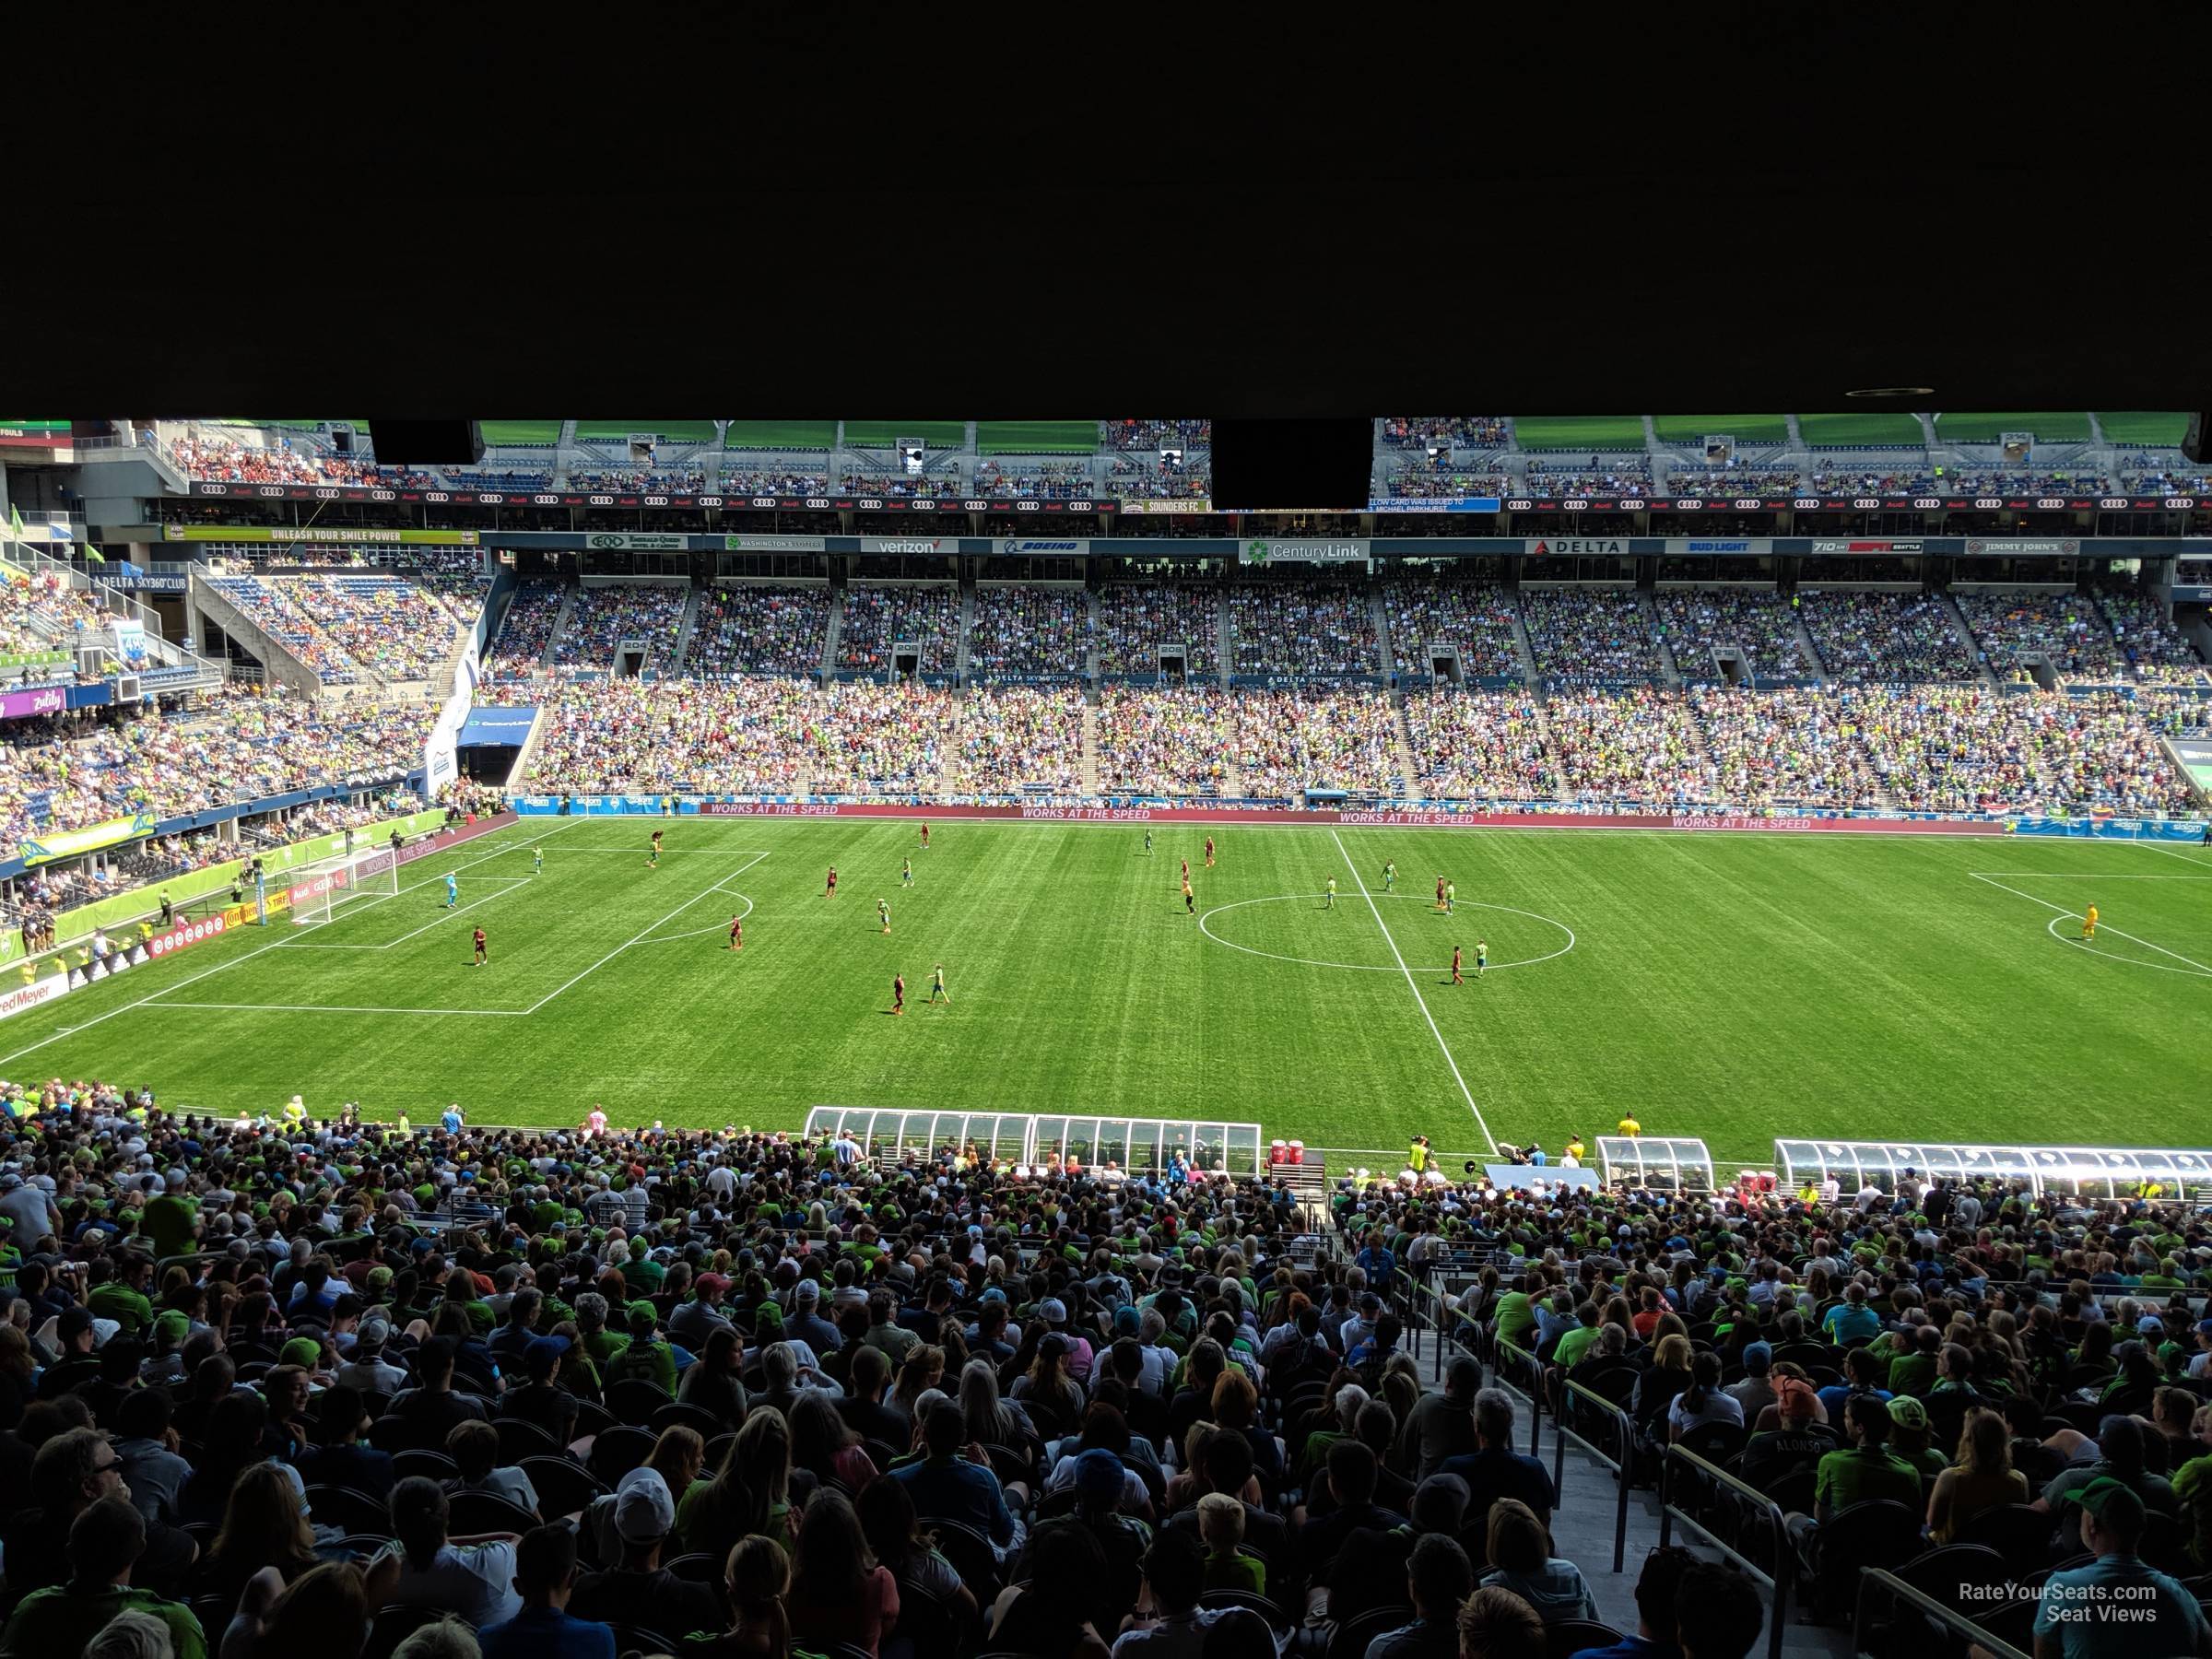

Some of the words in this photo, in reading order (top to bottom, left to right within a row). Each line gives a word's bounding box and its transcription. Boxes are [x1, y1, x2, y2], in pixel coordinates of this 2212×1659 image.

[1148, 502, 1188, 512] SOUNDERS
[1189, 502, 1198, 512] FC
[272, 530, 312, 540] UNLEASH
[314, 531, 338, 540] YOUR
[340, 531, 368, 541] SMILE
[370, 532, 401, 541] POWER
[879, 541, 934, 554] verizon
[1022, 542, 1077, 551] BOEING
[1273, 544, 1359, 559] CenturyLink
[1557, 541, 1620, 552] DELTA
[1688, 542, 1712, 551] BUD
[1714, 542, 1749, 551] LIGHT
[1814, 542, 1836, 551] 710
[1986, 543, 2020, 551] JIMMY
[2022, 543, 2059, 552] JOHN'S
[103, 577, 135, 588] DELTA
[168, 578, 186, 589] CLUB
[711, 804, 753, 813] WORKS
[756, 804, 770, 813] AT
[775, 805, 797, 814] THE
[800, 805, 838, 814] SPEED
[1022, 808, 1065, 818] WORKS
[1067, 809, 1084, 818] AT
[1086, 809, 1109, 818] THE
[1112, 810, 1150, 819] SPEED
[1340, 813, 1383, 823] WORKS
[1387, 813, 1403, 823] AT
[1406, 814, 1430, 823] THE
[1434, 814, 1474, 824] SPEED
[1673, 818, 1718, 828] WORKS
[1722, 818, 1738, 828] AT
[1741, 818, 1765, 829] THE
[1770, 819, 1811, 830] SPEED
[2172, 822, 2202, 832] slalom
[366, 855, 392, 873] WORKS
[402, 846, 416, 859] THE
[417, 840, 436, 855] SPEED
[294, 887, 310, 901] Audi
[17, 984, 50, 1006] Meyer
[1775, 1437, 1821, 1453] ALONSO
